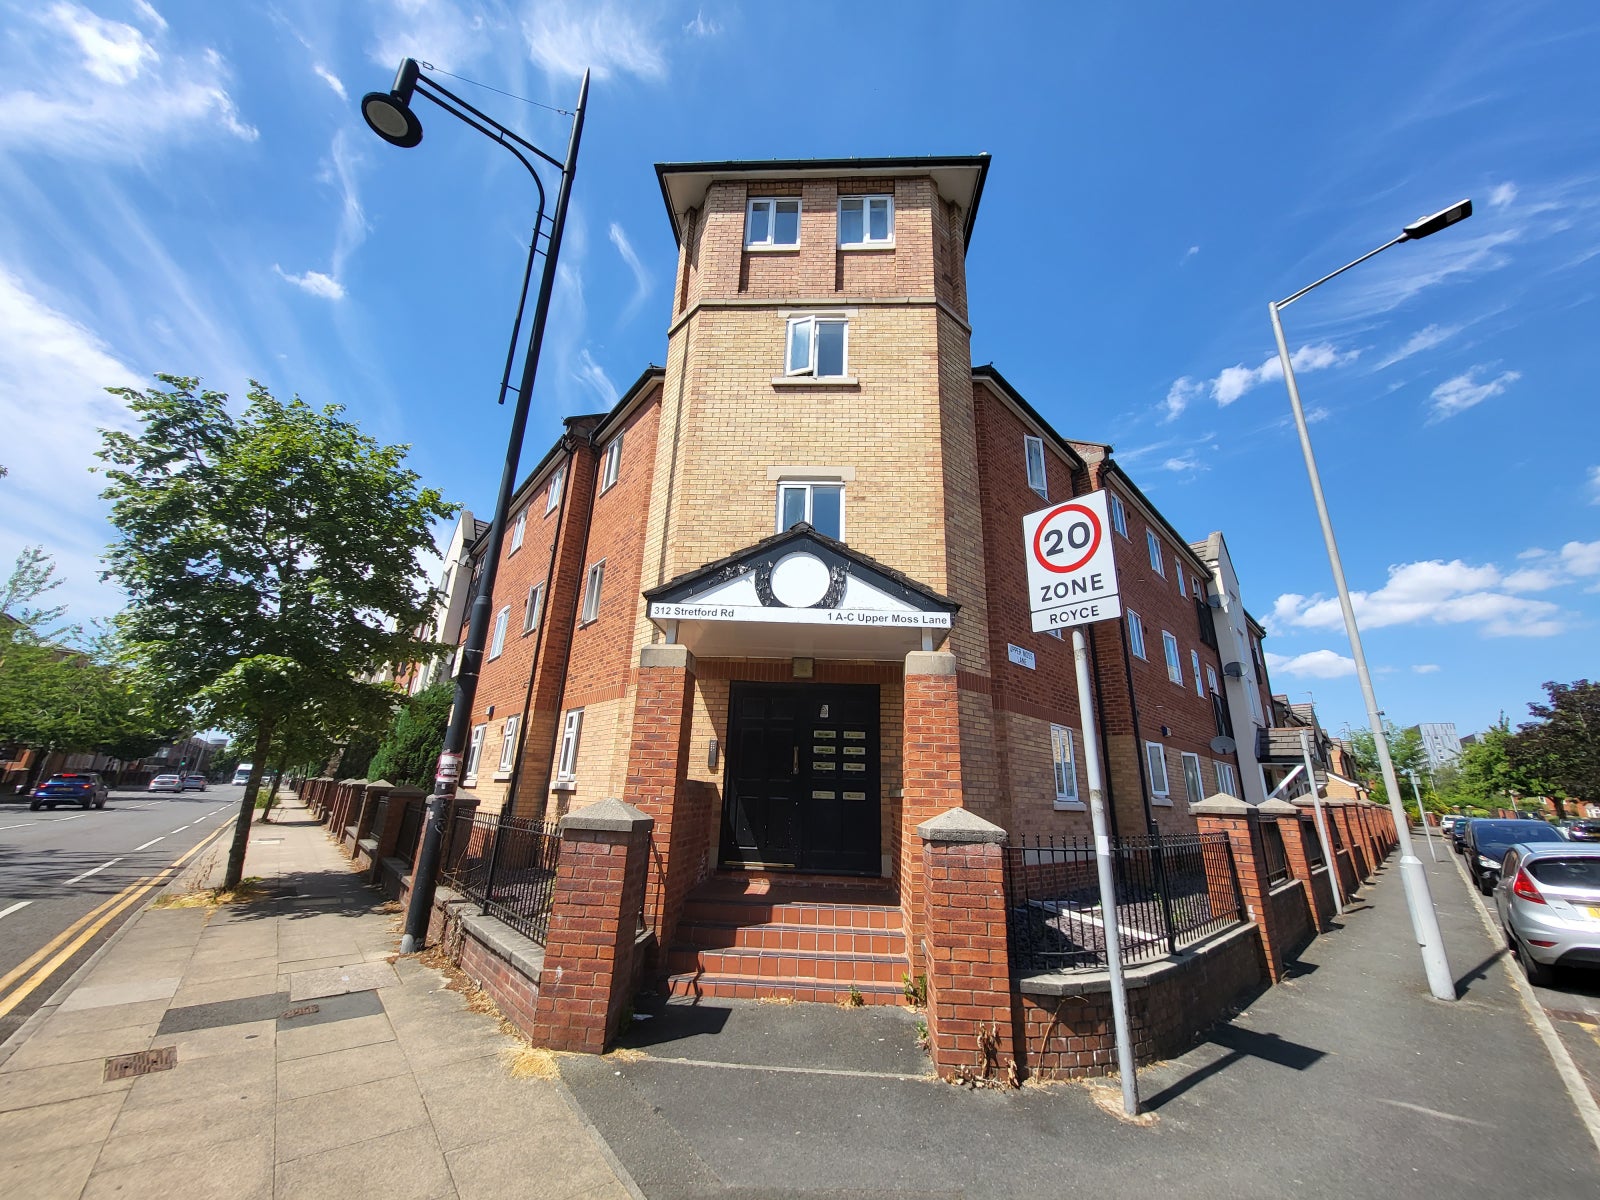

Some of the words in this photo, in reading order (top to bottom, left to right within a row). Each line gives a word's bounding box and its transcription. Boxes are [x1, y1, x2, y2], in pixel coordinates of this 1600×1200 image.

[1044, 522, 1090, 556] 20
[1040, 573, 1104, 602] ZONE
[654, 606, 671, 615] 312
[674, 607, 717, 617] Stretford
[720, 608, 734, 617] Rd
[827, 612, 832, 621] 1
[835, 612, 854, 621] A-C
[857, 613, 889, 624] Upper
[892, 614, 919, 624] Moss
[922, 615, 947, 624] Lane
[1049, 605, 1100, 624] ROYCE
